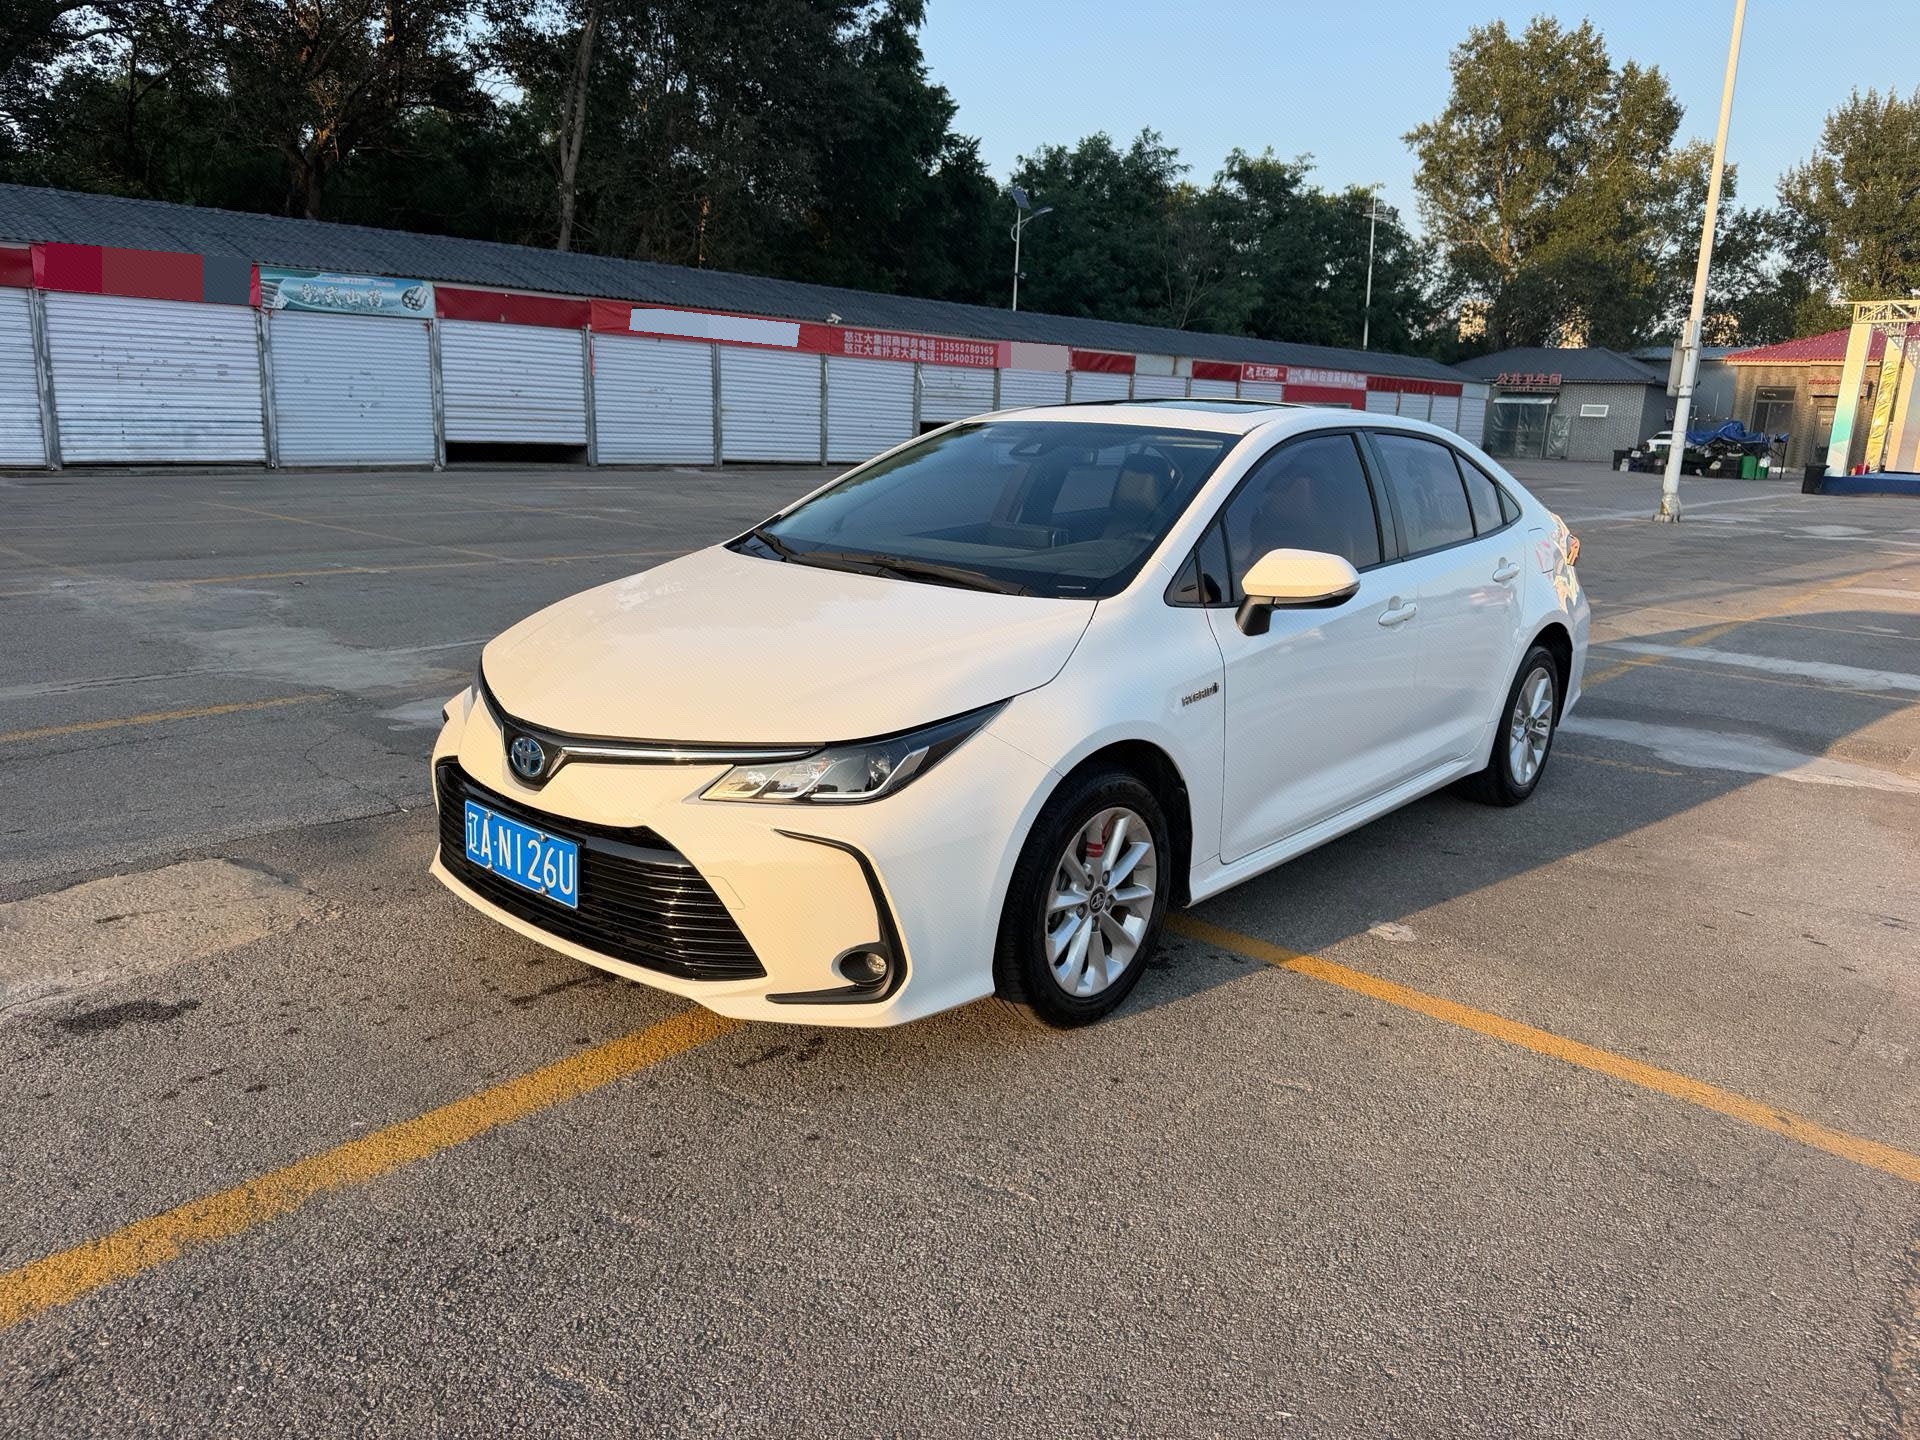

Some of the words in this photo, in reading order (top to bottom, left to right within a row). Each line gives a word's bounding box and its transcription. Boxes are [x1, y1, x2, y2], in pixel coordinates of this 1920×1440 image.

[1496, 372, 1562, 385] 公共卫生间
[1182, 686, 1216, 707] HYBRID
